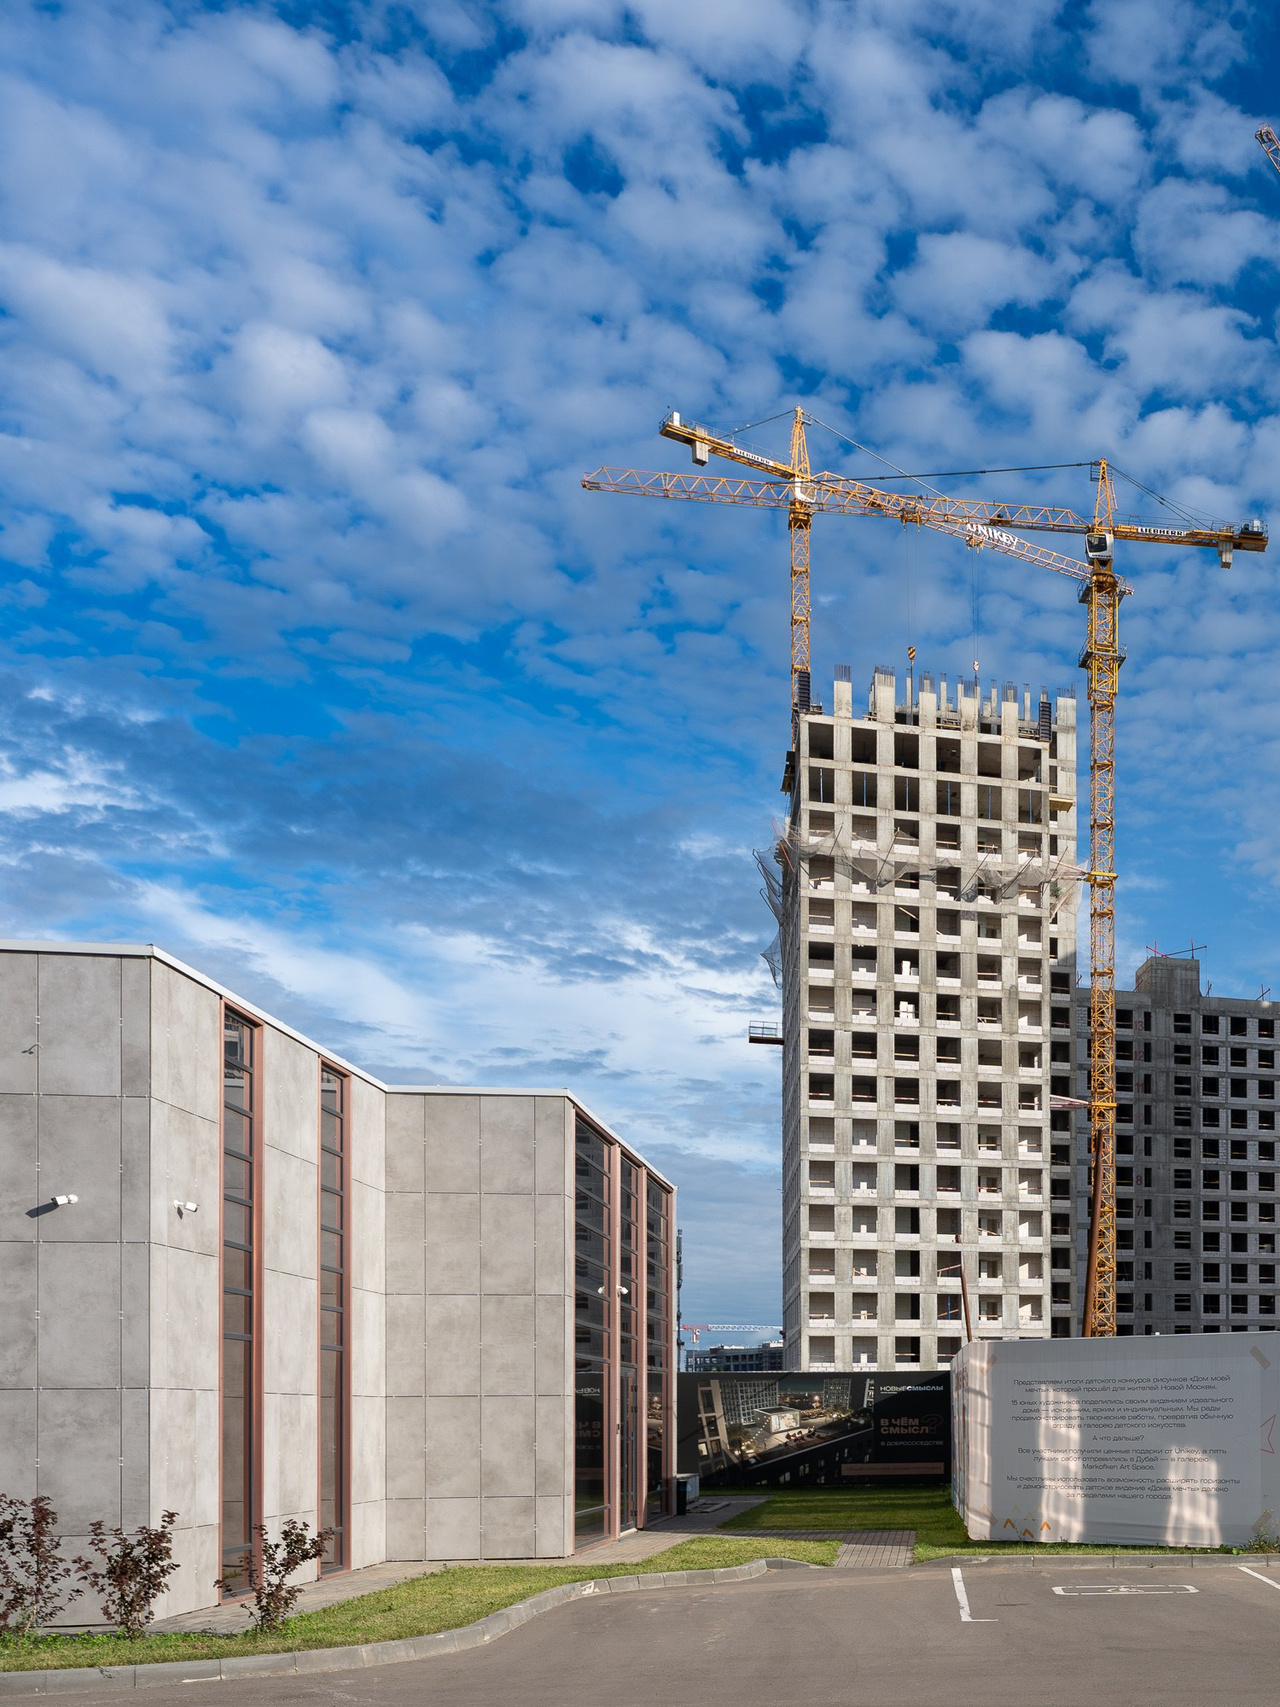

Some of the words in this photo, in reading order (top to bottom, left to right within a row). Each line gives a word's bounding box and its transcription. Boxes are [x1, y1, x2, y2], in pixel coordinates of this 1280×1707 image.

[966, 523, 1018, 546] UNIKEY
[1140, 528, 1183, 536] LIEBHERR
[1134, 1020, 1144, 1031] 13
[1134, 1050, 1144, 1061] 12
[1136, 1174, 1143, 1185] 8
[1136, 1205, 1143, 1216] 7
[1136, 1270, 1143, 1281] 5
[1013, 1379, 1063, 1387] Представляем
[1210, 1374, 1231, 1382] моей
[880, 1418, 889, 1426] В
[891, 1416, 919, 1426] ЧЁМ
[1200, 1413, 1234, 1421] обычную
[1113, 1434, 1145, 1442] дальше?
